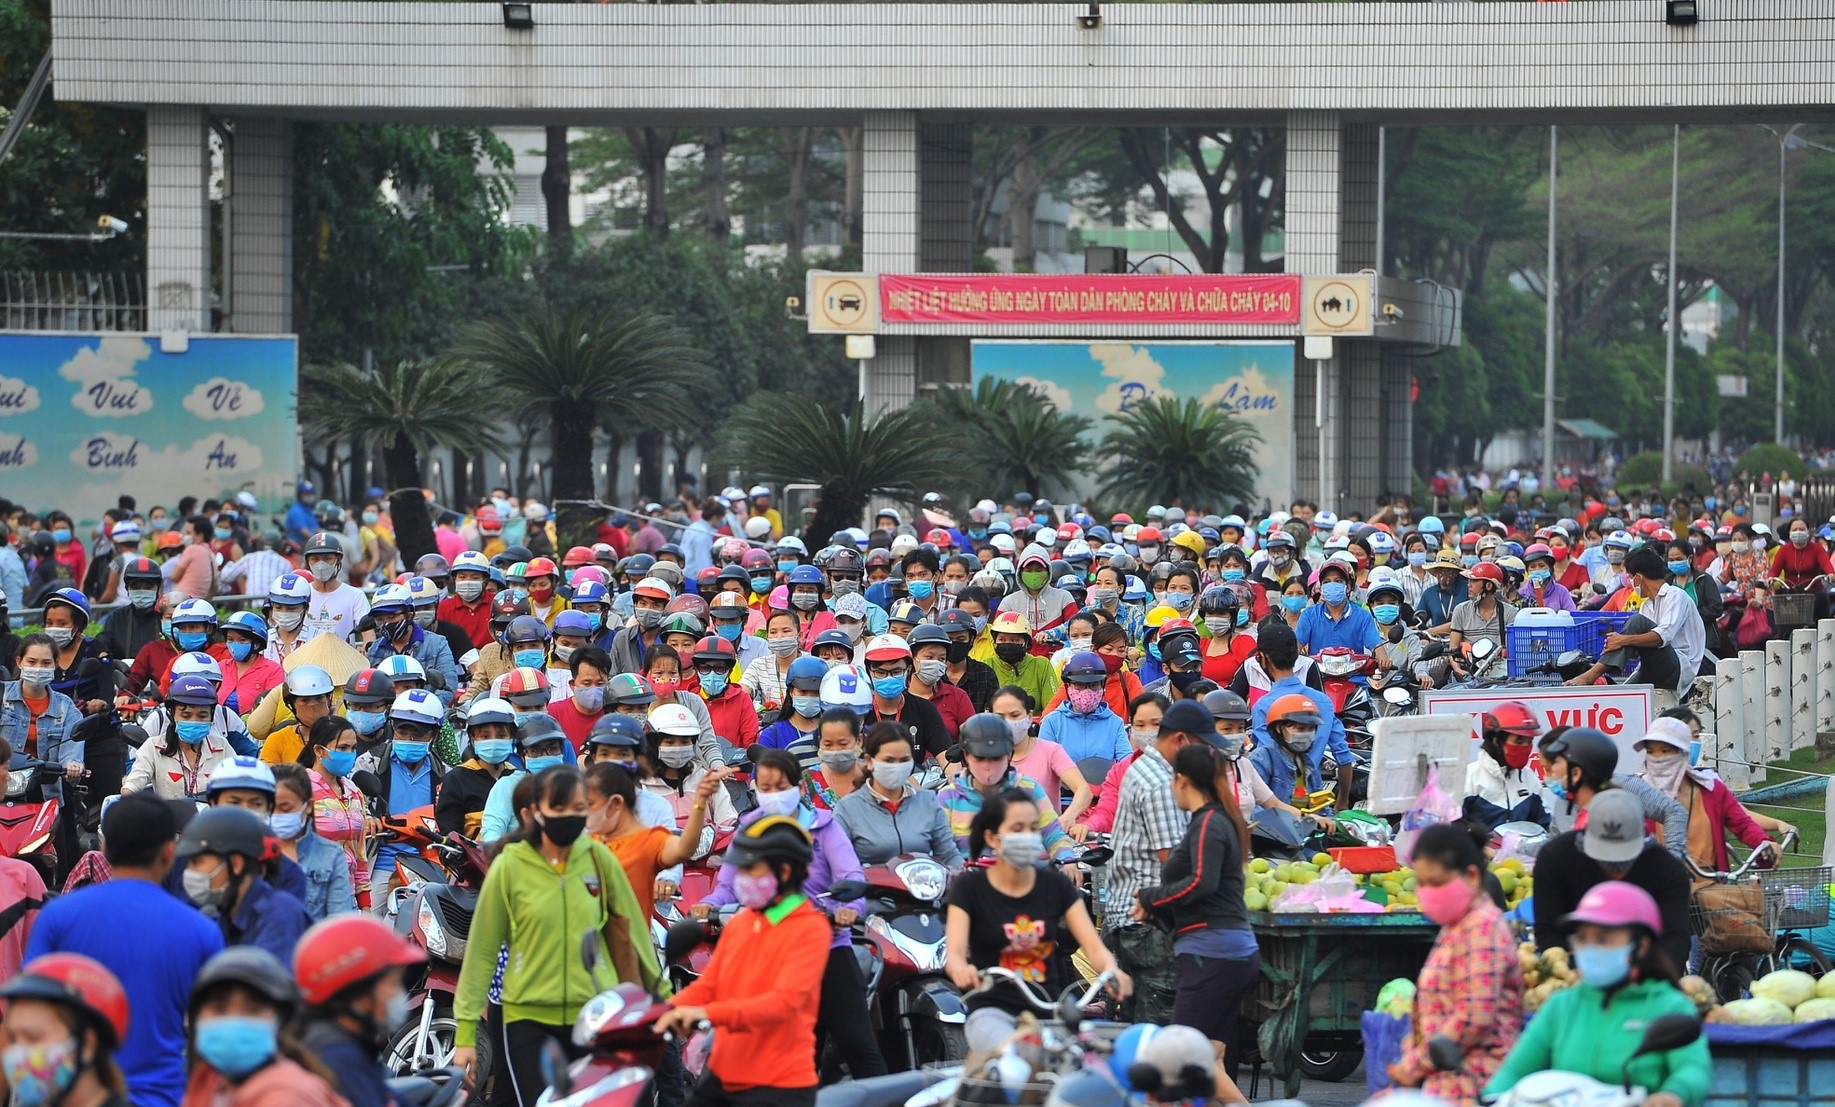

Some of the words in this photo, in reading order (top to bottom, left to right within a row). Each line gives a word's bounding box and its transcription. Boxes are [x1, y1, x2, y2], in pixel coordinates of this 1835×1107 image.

[923, 286, 947, 315] LIỆT
[990, 286, 1014, 312] ỨNG
[1016, 286, 1047, 312] NGÀY
[1048, 286, 1079, 312] TOÀN
[1081, 286, 1104, 312] DÂN
[1106, 286, 1145, 312] PHÒNG
[1147, 286, 1178, 312] CHÁY
[1180, 286, 1195, 312] VÀ
[1197, 287, 1228, 312] CHỮA
[1230, 286, 1261, 312] CHÁY
[0, 383, 26, 408] ui
[89, 381, 139, 409] Vui
[1218, 382, 1278, 411] Làm
[205, 439, 237, 470] An
